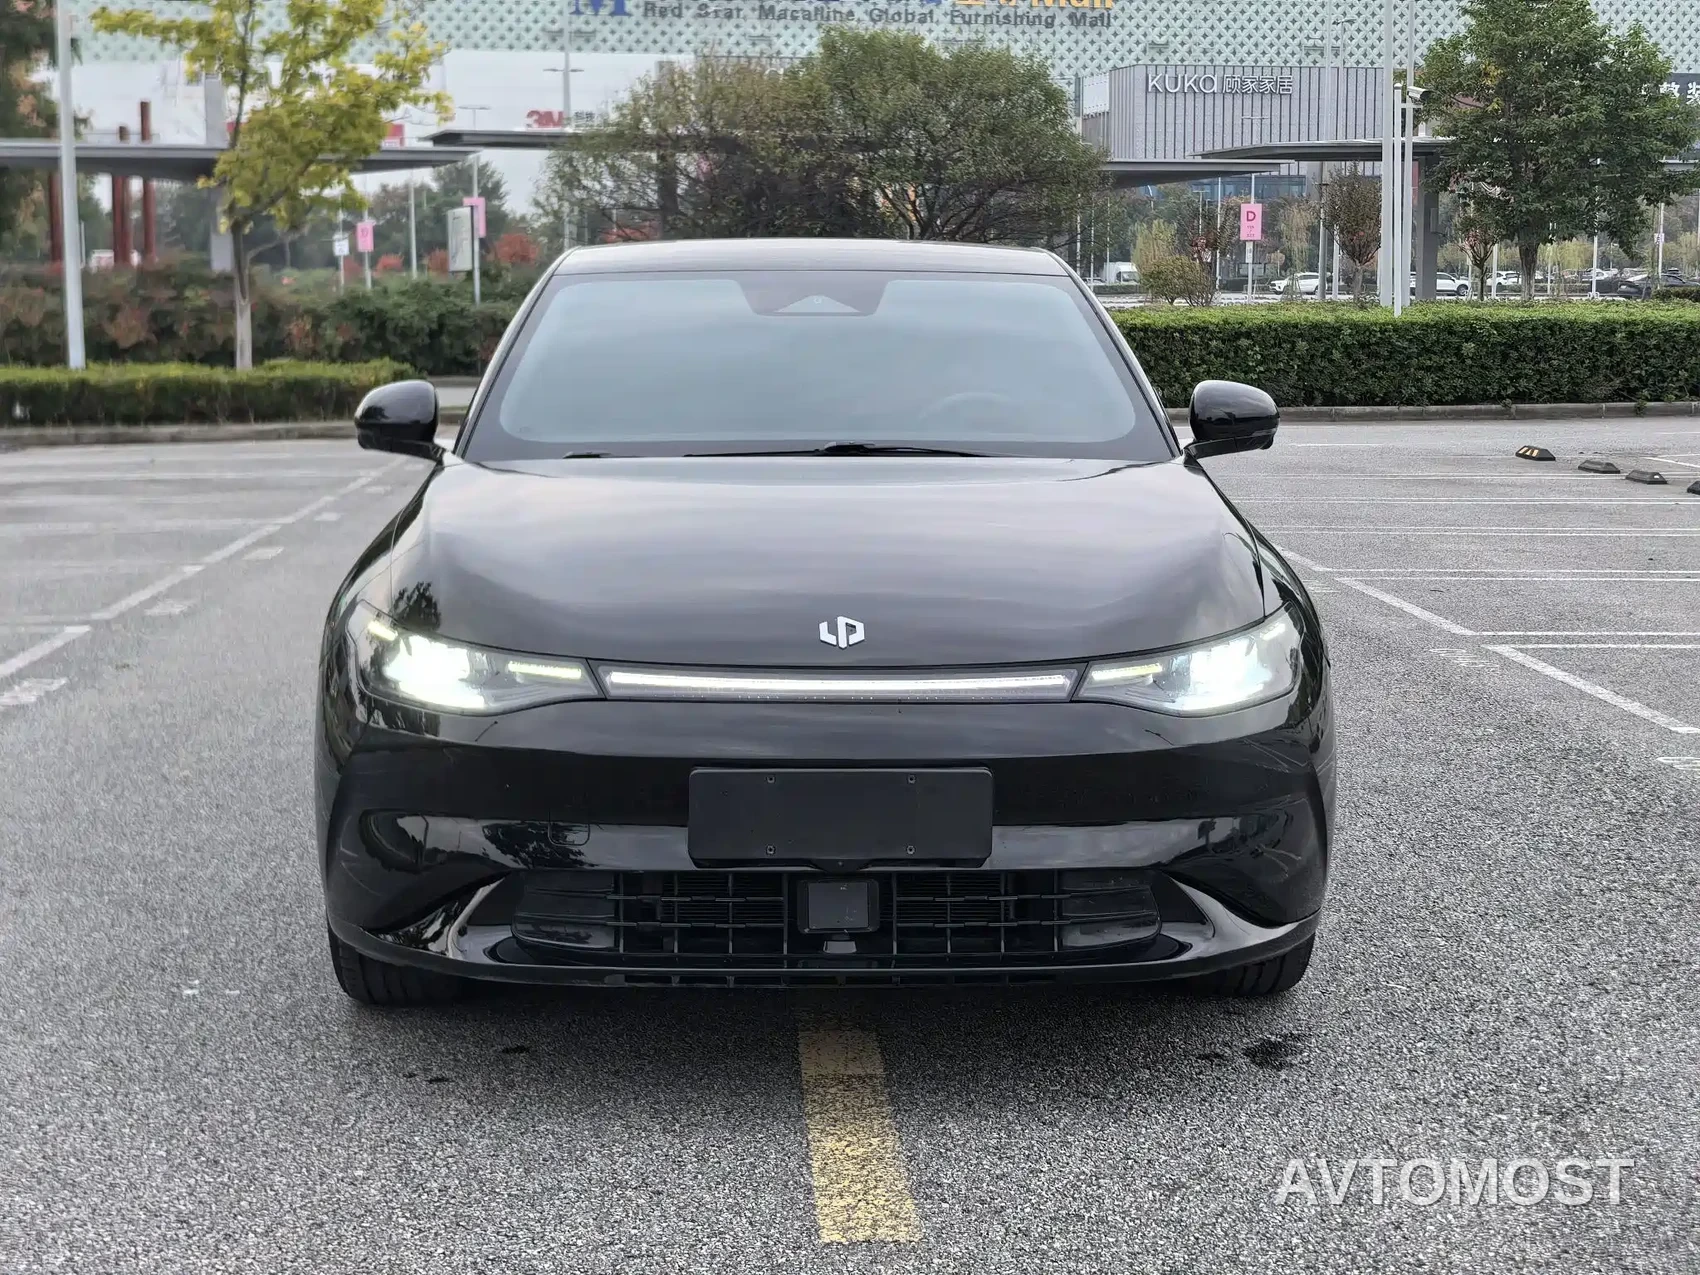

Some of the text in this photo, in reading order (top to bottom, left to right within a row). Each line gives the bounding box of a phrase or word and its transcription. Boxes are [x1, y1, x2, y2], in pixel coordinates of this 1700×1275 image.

[643, 1, 684, 18] Red
[869, 8, 934, 24] Global
[950, 10, 1055, 28] Furnishing
[1068, 11, 1111, 27] Mall
[1223, 74, 1293, 94] 顾家家居
[526, 110, 564, 128] 3M
[1246, 211, 1256, 222] D
